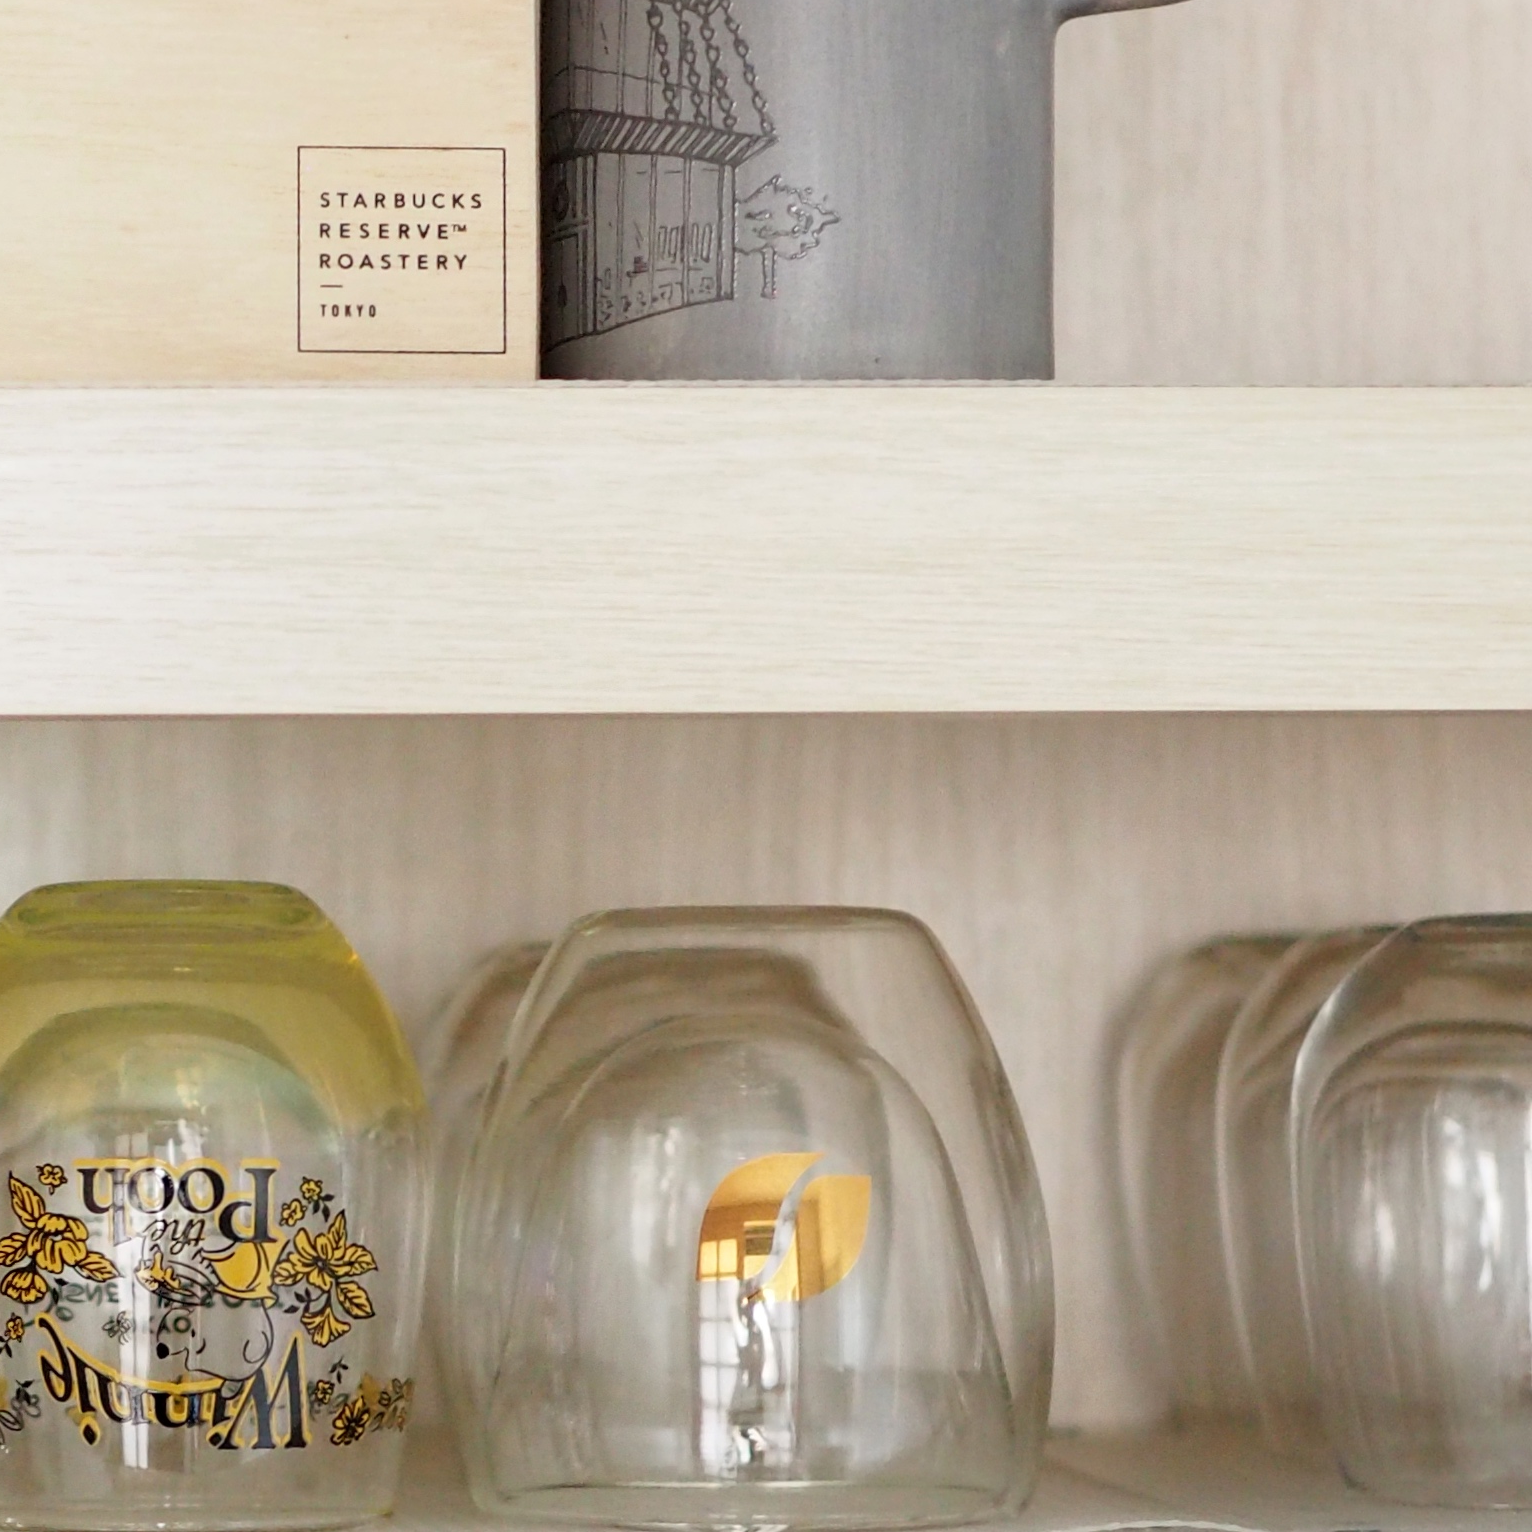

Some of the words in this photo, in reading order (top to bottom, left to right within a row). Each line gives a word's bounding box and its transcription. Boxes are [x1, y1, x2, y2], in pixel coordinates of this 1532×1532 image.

[319, 191, 483, 210] STARBUCKS
[318, 253, 468, 271] ROASTERY
[319, 303, 378, 319] TOKYO
[74, 1162, 280, 1246] Pooh
[142, 1217, 208, 1256] the
[38, 1311, 310, 1451] Winnie
